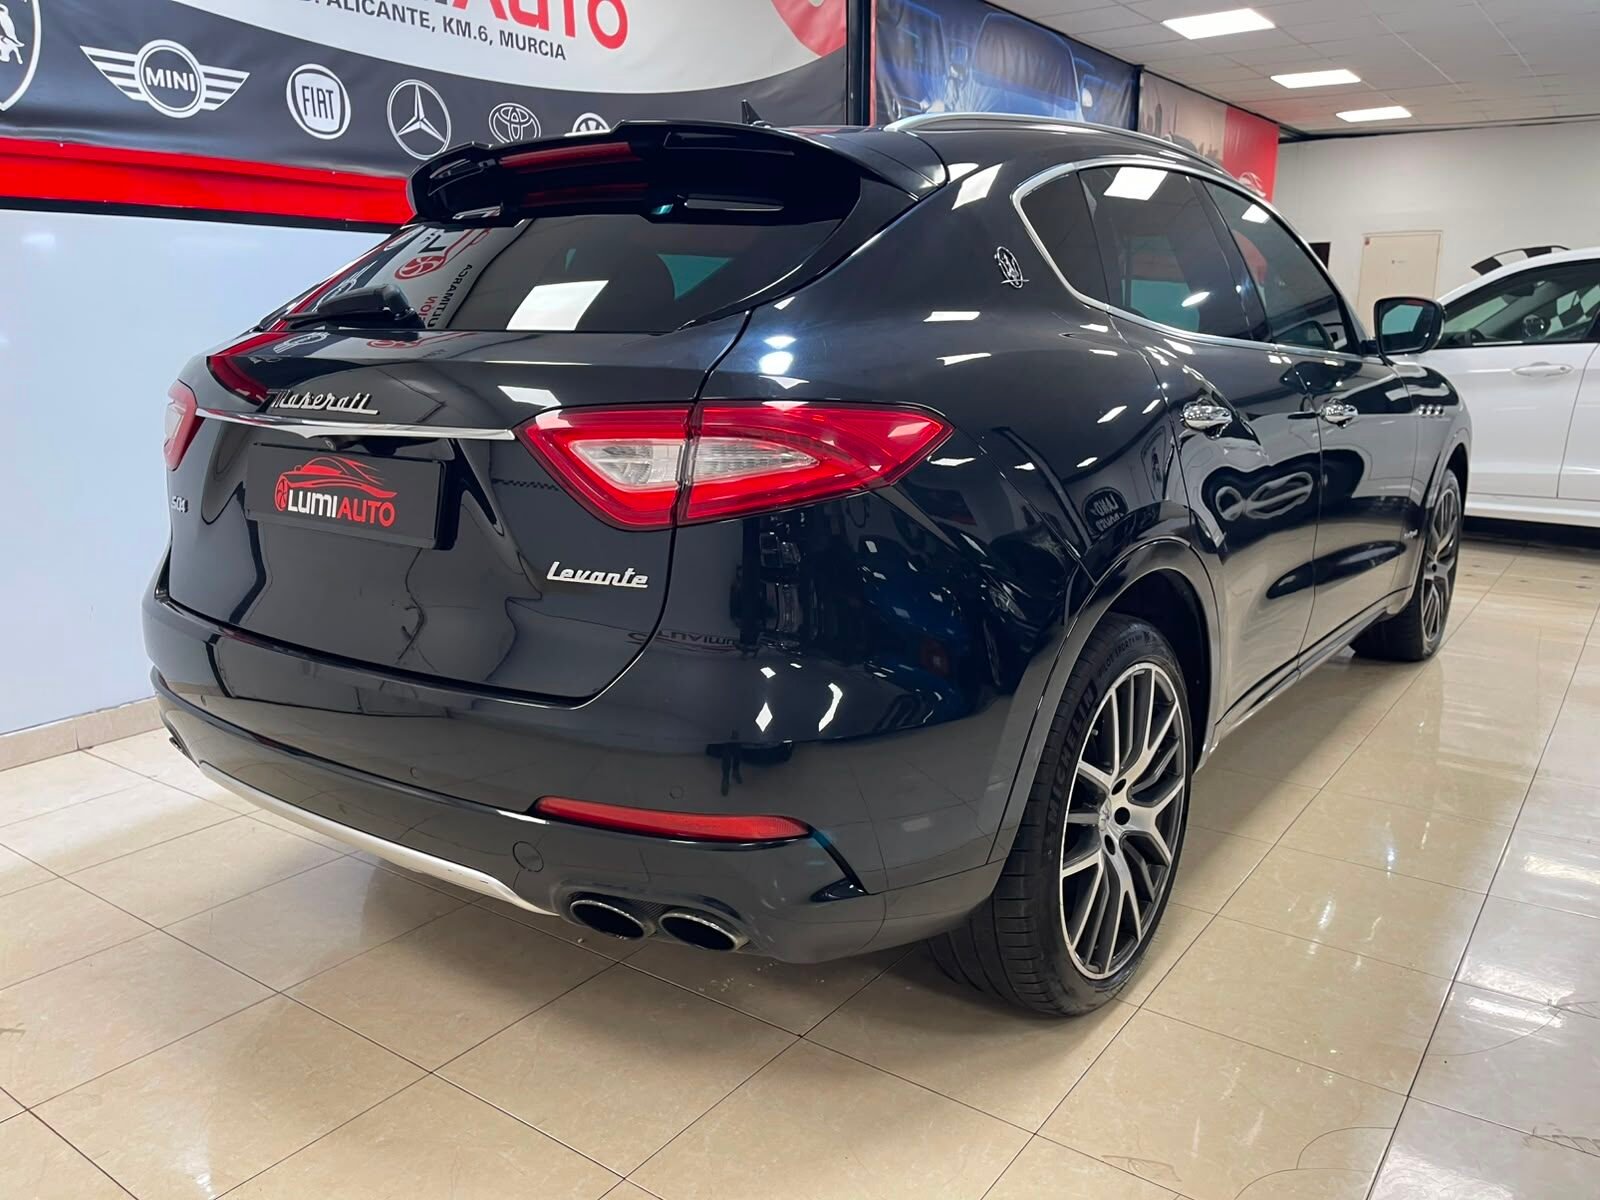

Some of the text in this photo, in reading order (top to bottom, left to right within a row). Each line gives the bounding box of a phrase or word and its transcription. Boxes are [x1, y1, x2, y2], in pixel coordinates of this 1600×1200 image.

[442, 16, 493, 46] KM.6,
[499, 30, 566, 60] MURCIA
[145, 67, 196, 92] MINI
[302, 85, 335, 120] FIAT
[266, 388, 379, 415] Maserati
[546, 561, 648, 588] Levante
